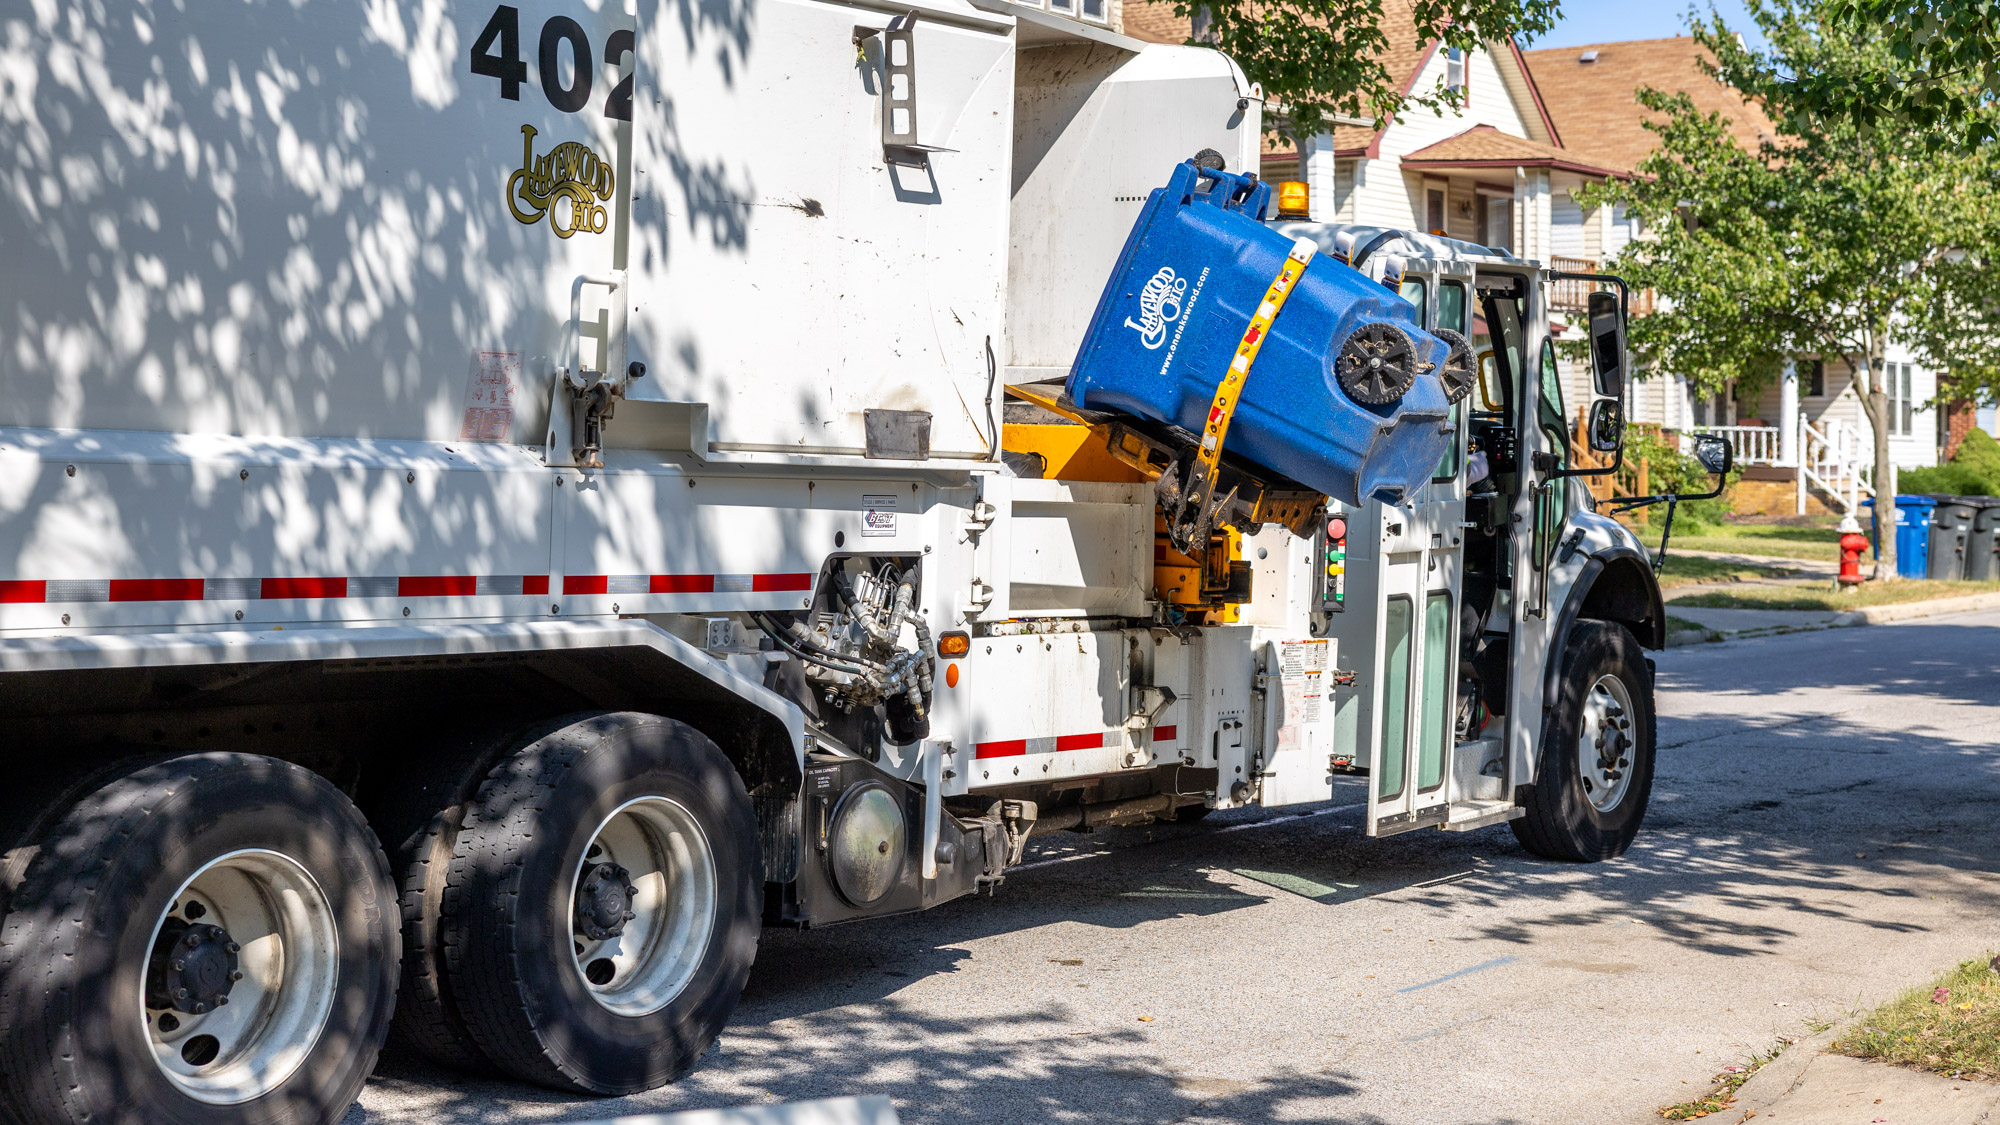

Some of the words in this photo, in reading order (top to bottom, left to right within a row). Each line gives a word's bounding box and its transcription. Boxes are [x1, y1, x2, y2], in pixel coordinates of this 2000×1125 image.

[470, 5, 635, 122] 402
[507, 124, 614, 225] LAKEWOOD
[550, 187, 608, 239] OHIO
[1123, 266, 1176, 350] LAKEWOOD
[1160, 277, 1187, 321] OHIO
[1160, 266, 1210, 375] www.onelakewood.com
[869, 513, 894, 523] BEST
